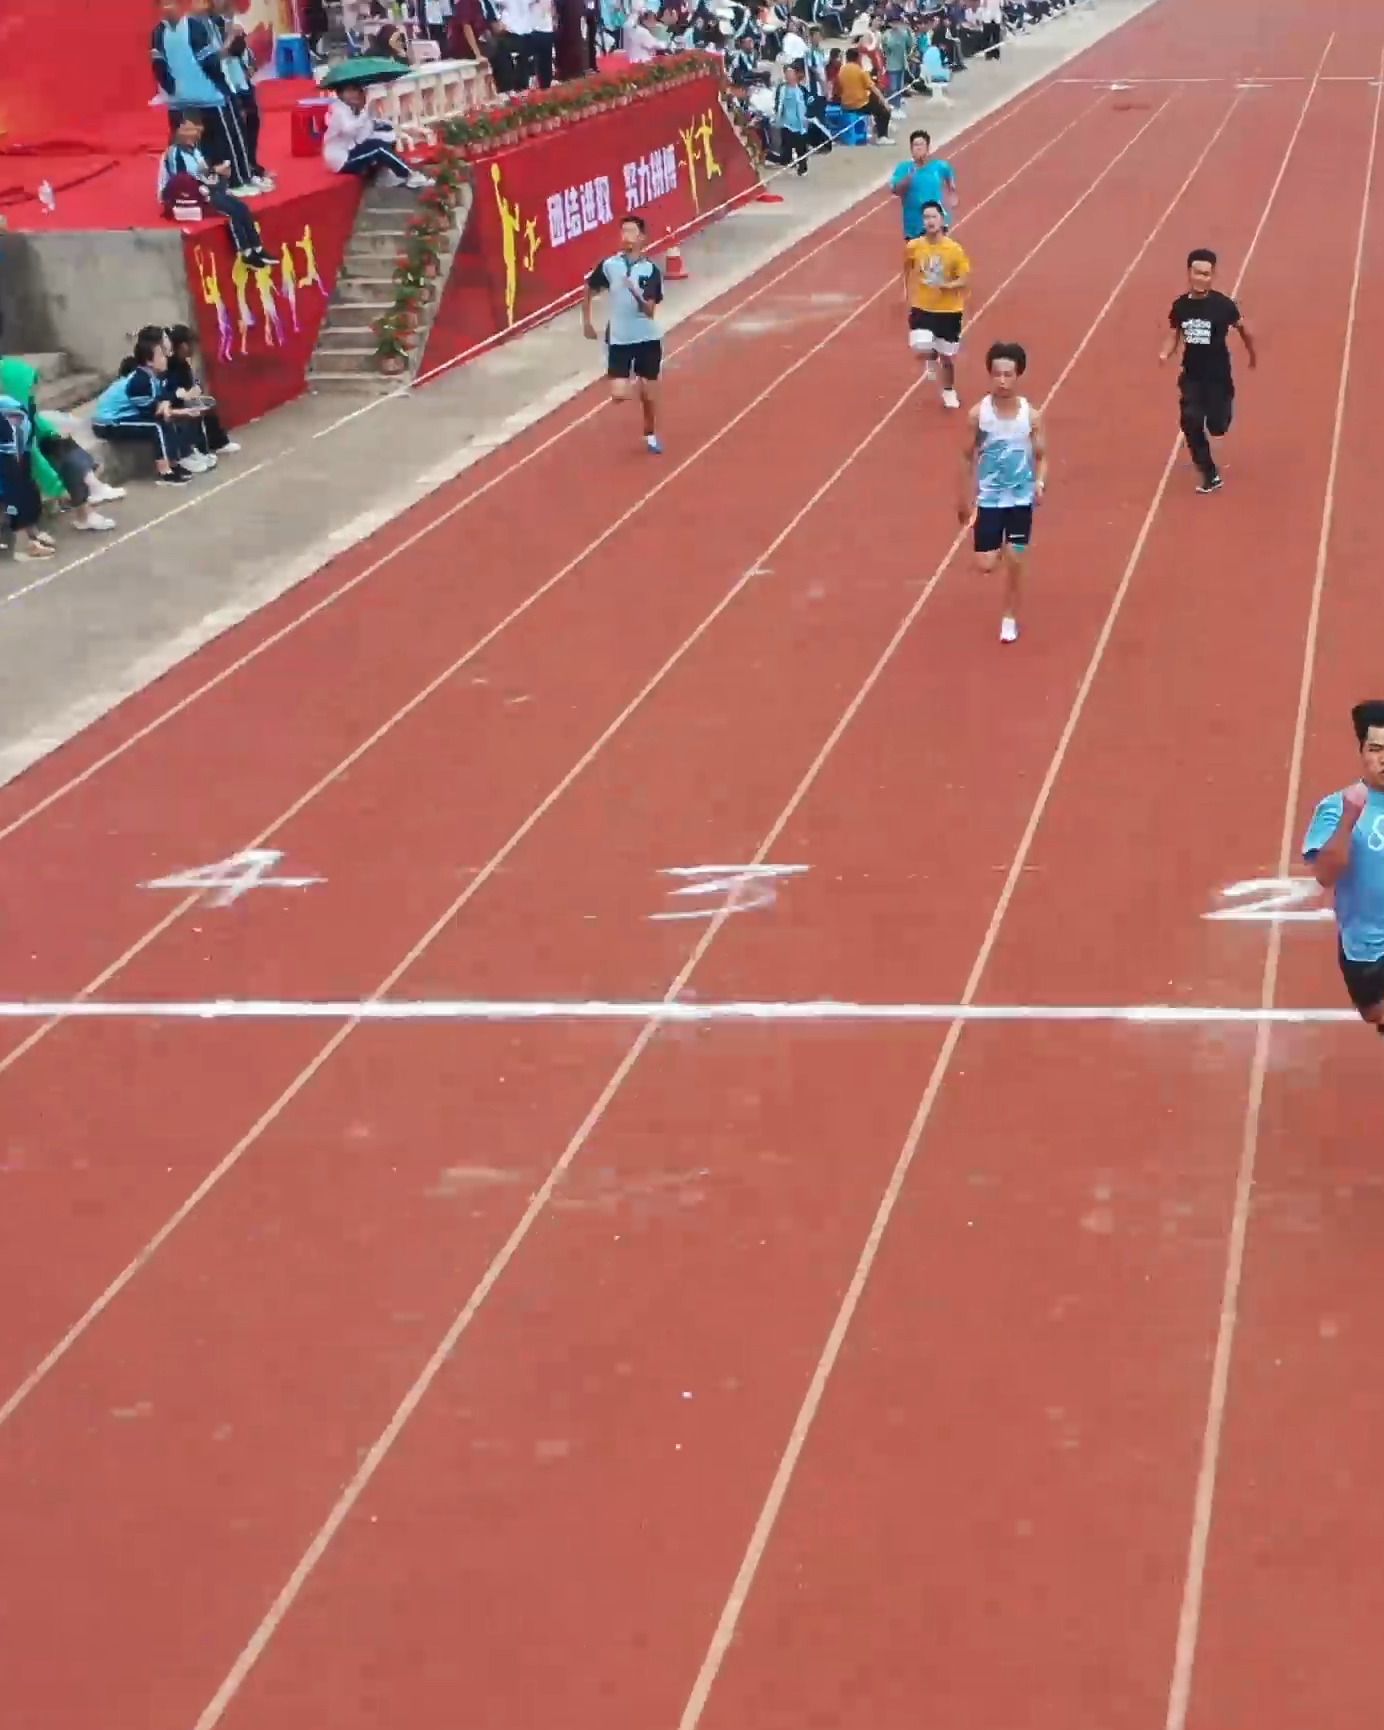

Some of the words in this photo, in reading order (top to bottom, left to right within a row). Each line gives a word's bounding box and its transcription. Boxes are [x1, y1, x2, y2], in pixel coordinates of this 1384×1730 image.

[137, 849, 328, 907] 4
[648, 863, 815, 920] 3
[1200, 877, 1336, 921] 2
